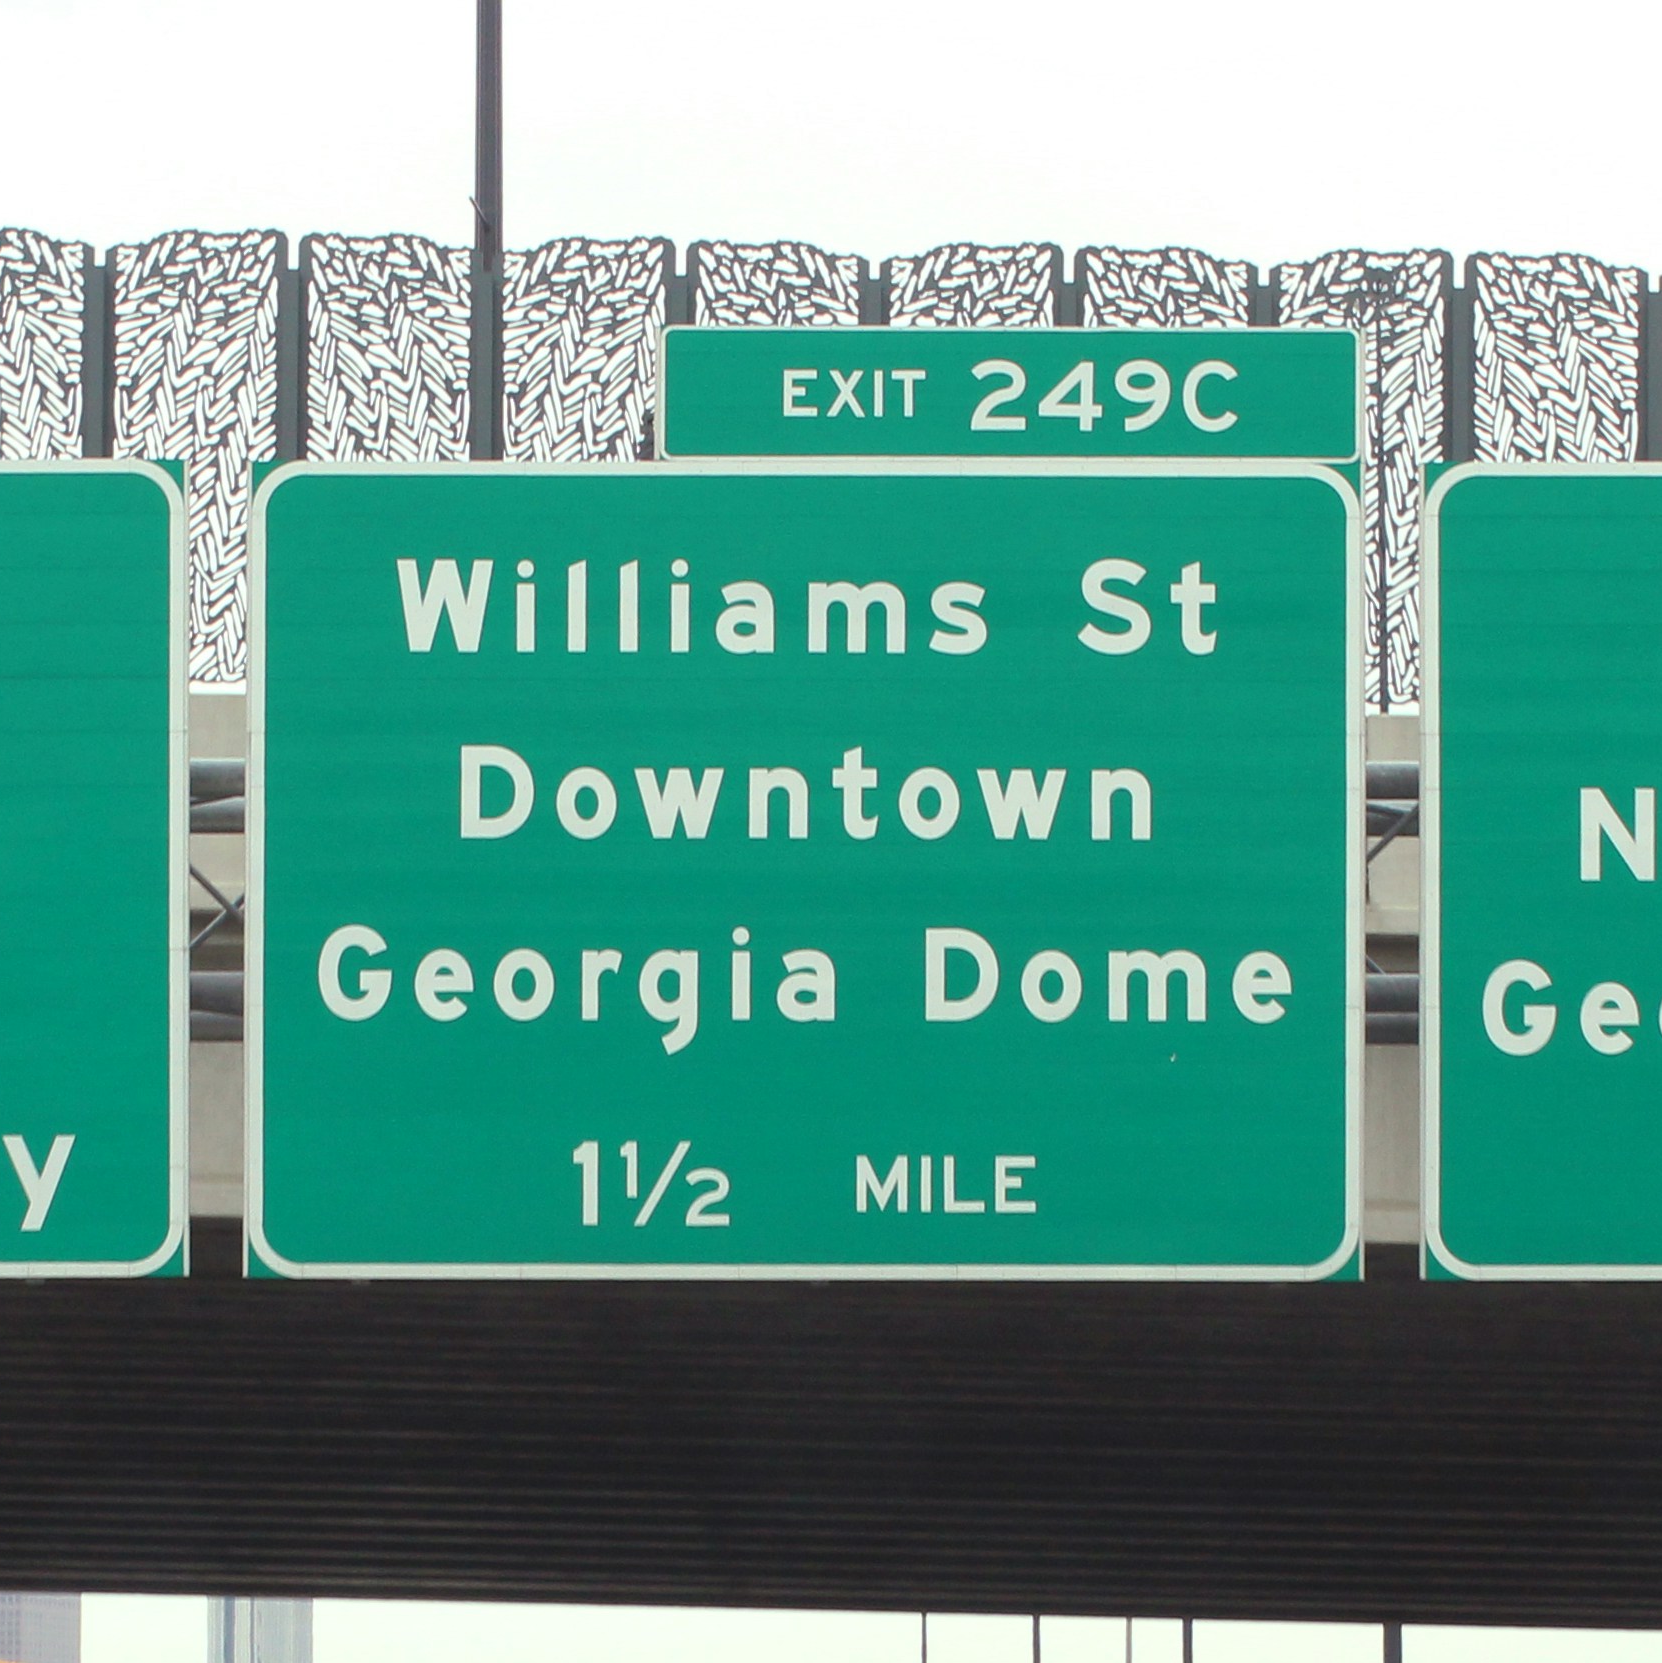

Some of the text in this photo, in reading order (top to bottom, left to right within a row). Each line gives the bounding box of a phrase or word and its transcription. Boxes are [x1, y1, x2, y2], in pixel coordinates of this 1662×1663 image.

[783, 359, 1237, 432] EXIT 249C
[397, 559, 1217, 654] Williams St
[461, 745, 1151, 840] Downtown
[318, 925, 1291, 1054] Georgia Dome
[856, 1154, 1037, 1213] MILE
